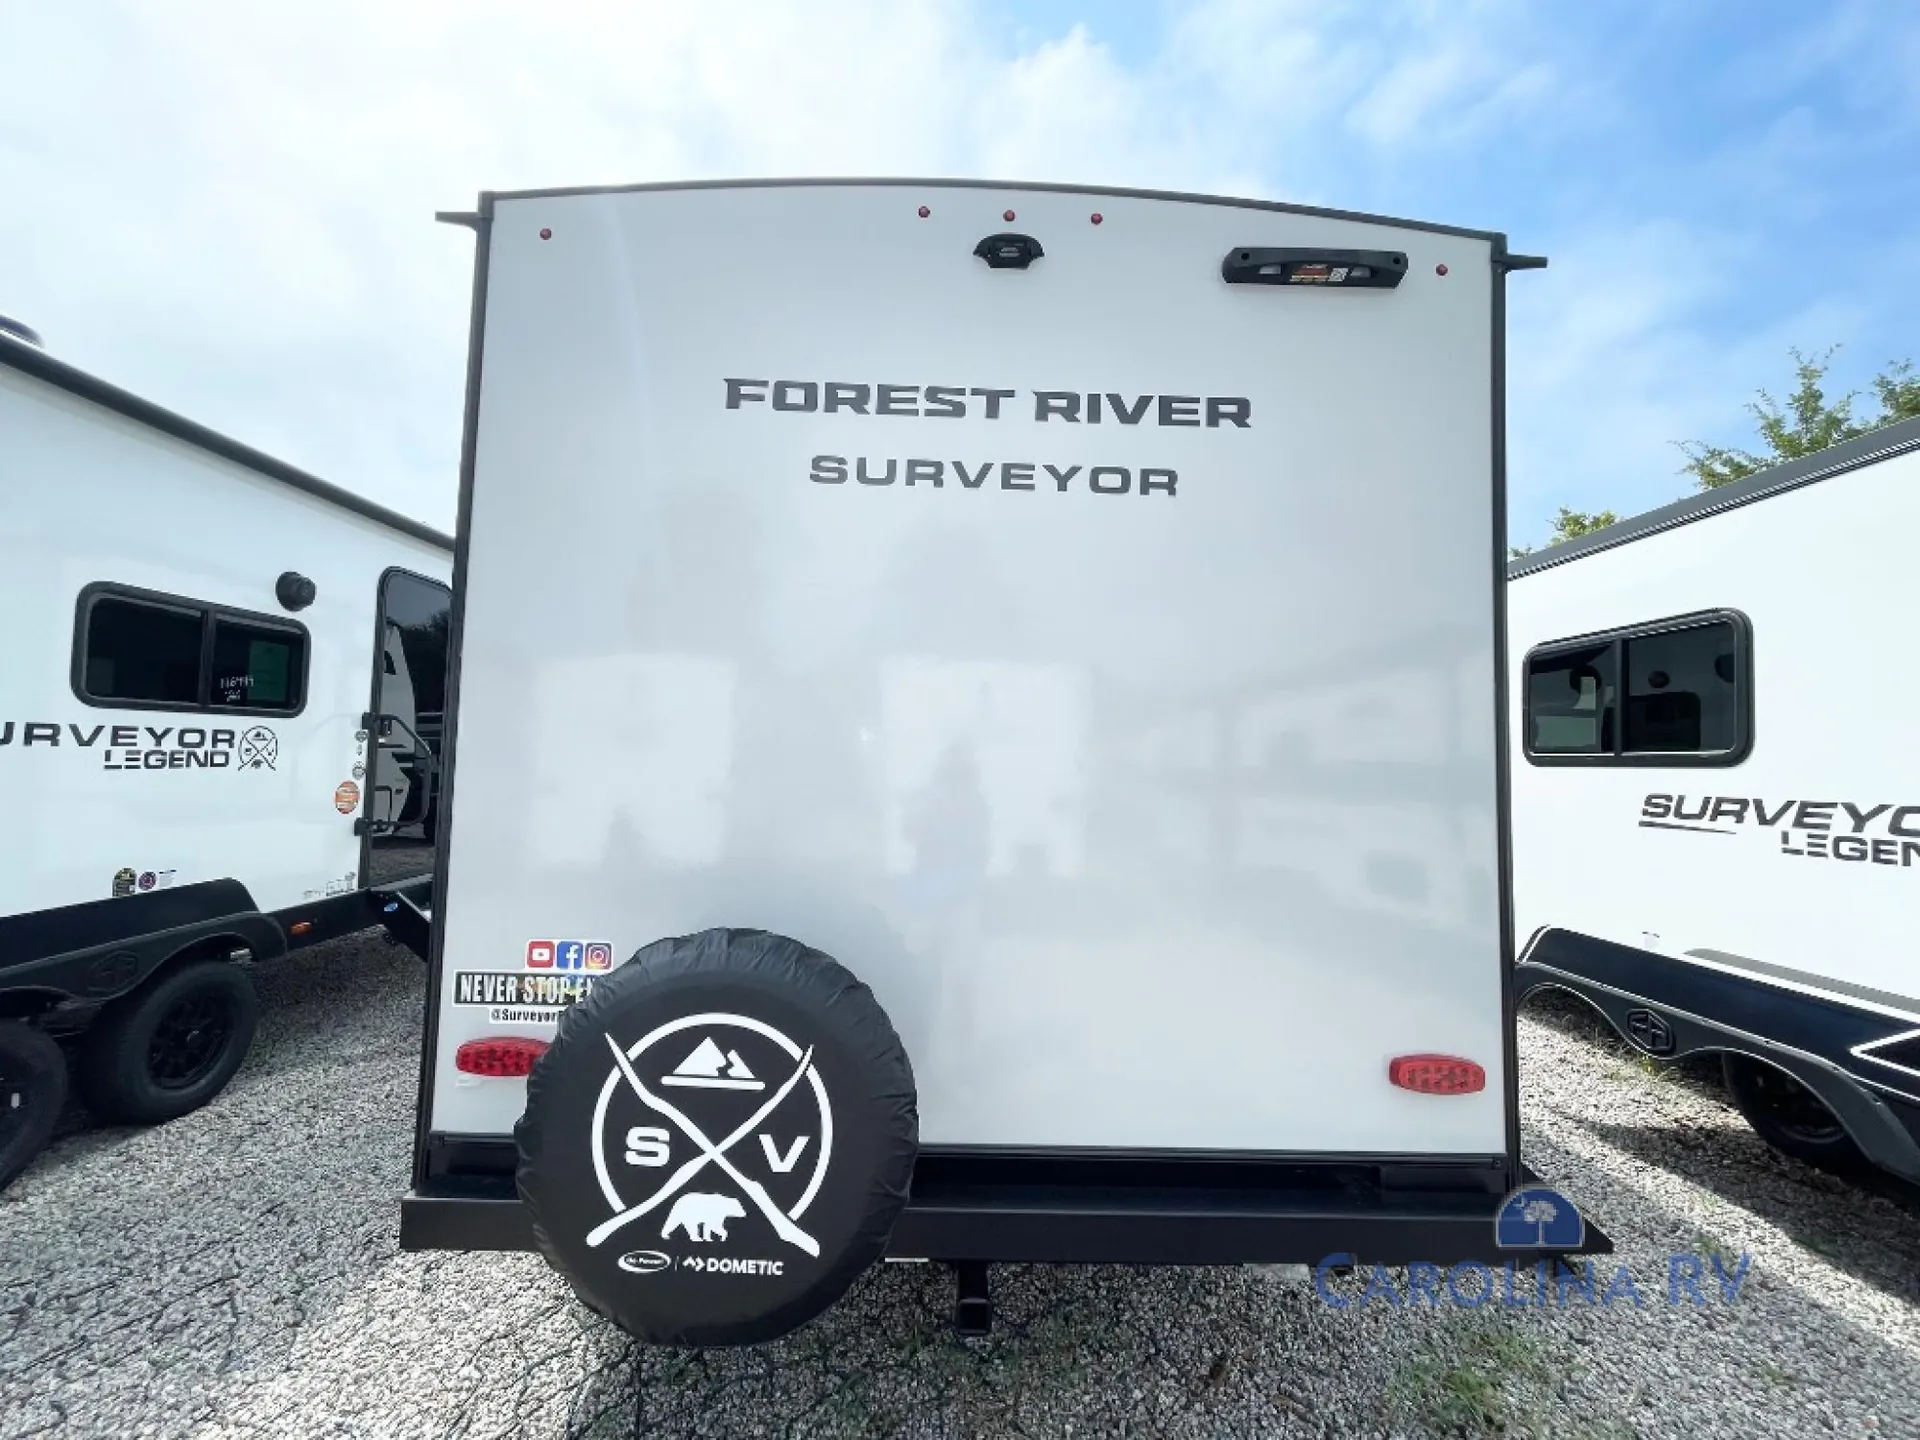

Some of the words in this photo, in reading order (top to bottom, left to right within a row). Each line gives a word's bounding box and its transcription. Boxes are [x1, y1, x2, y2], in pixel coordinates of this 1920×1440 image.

[724, 378, 1015, 420] FOREST
[1032, 390, 1252, 428] RIVER
[809, 455, 1178, 497] SURVEYOR
[104, 749, 230, 770] LEGEND
[1642, 793, 1920, 838] SURVEYO
[460, 974, 517, 1002] NEVER
[522, 976, 569, 1004] STOP
[625, 1126, 670, 1167] S
[758, 1133, 811, 1172] V
[706, 1257, 784, 1276] DOMETIC
